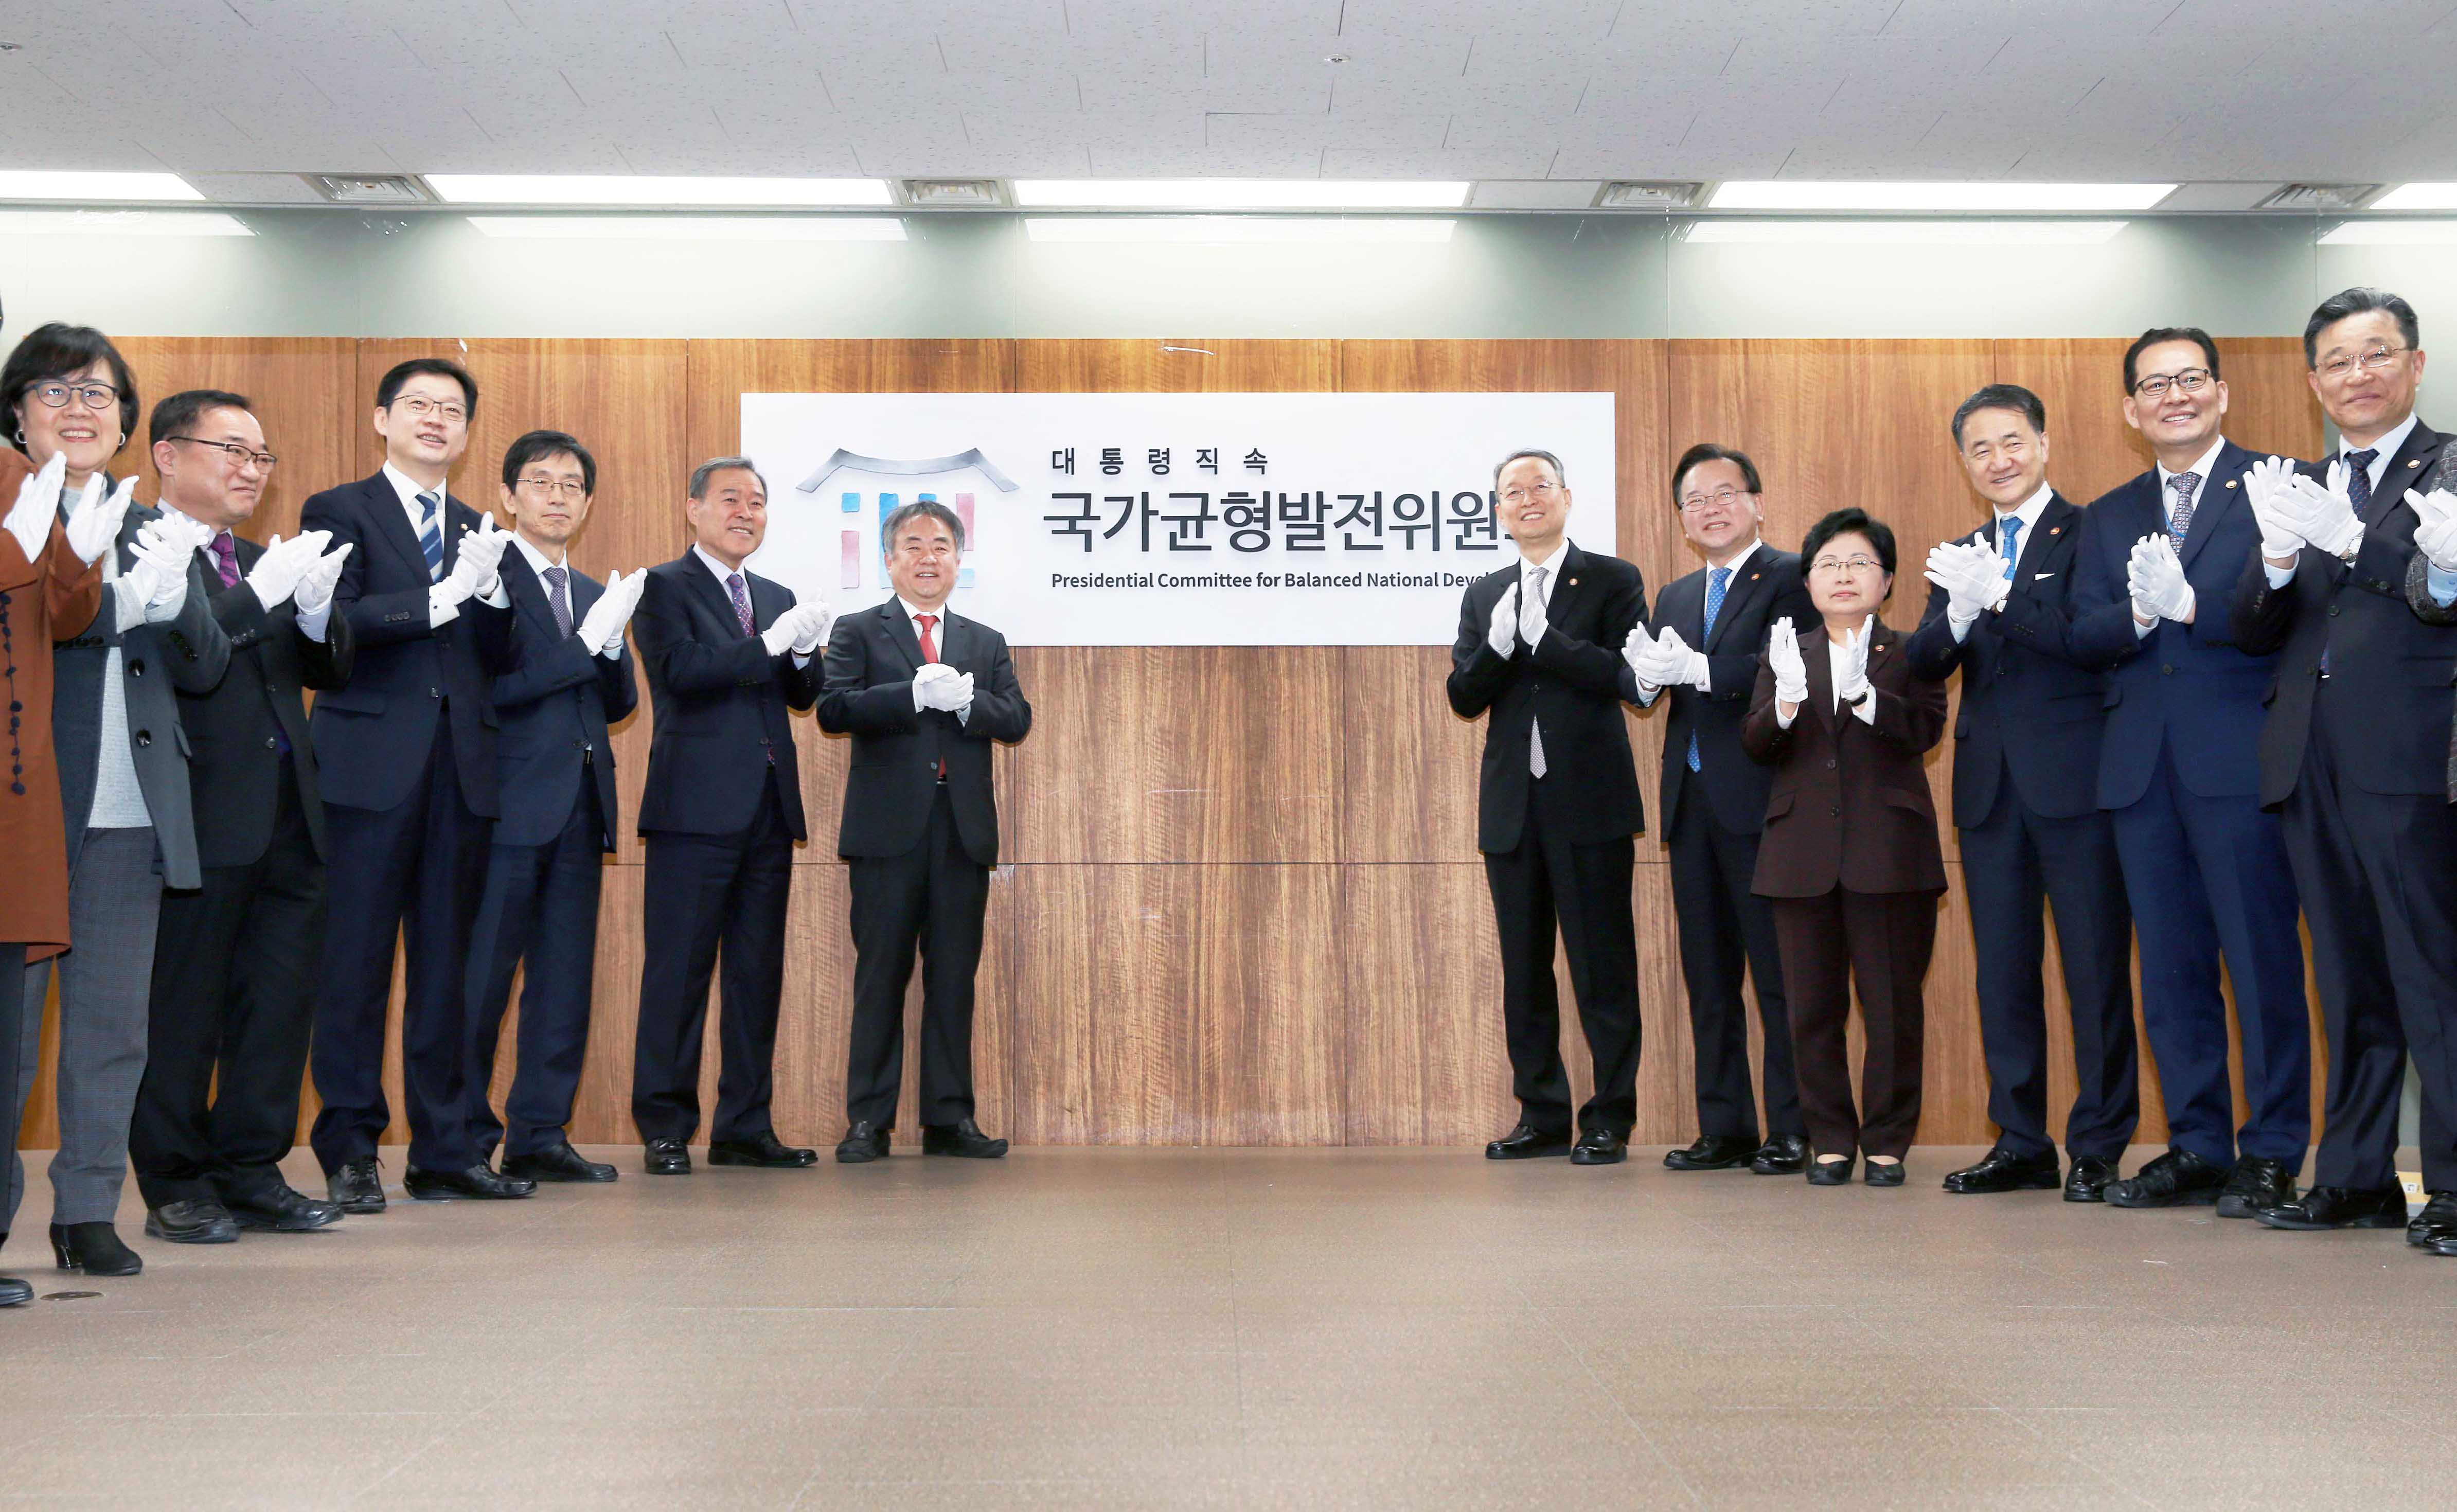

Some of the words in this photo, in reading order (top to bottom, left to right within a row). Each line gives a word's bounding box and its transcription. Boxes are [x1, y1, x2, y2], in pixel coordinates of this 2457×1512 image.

[1043, 491, 1514, 553] 국가균형발전위원
[1052, 572, 1154, 588] Presidential
[1158, 572, 1252, 588] Committee
[1256, 572, 1281, 588] for
[1285, 572, 1362, 587] Balanced
[1367, 572, 1439, 587] National
